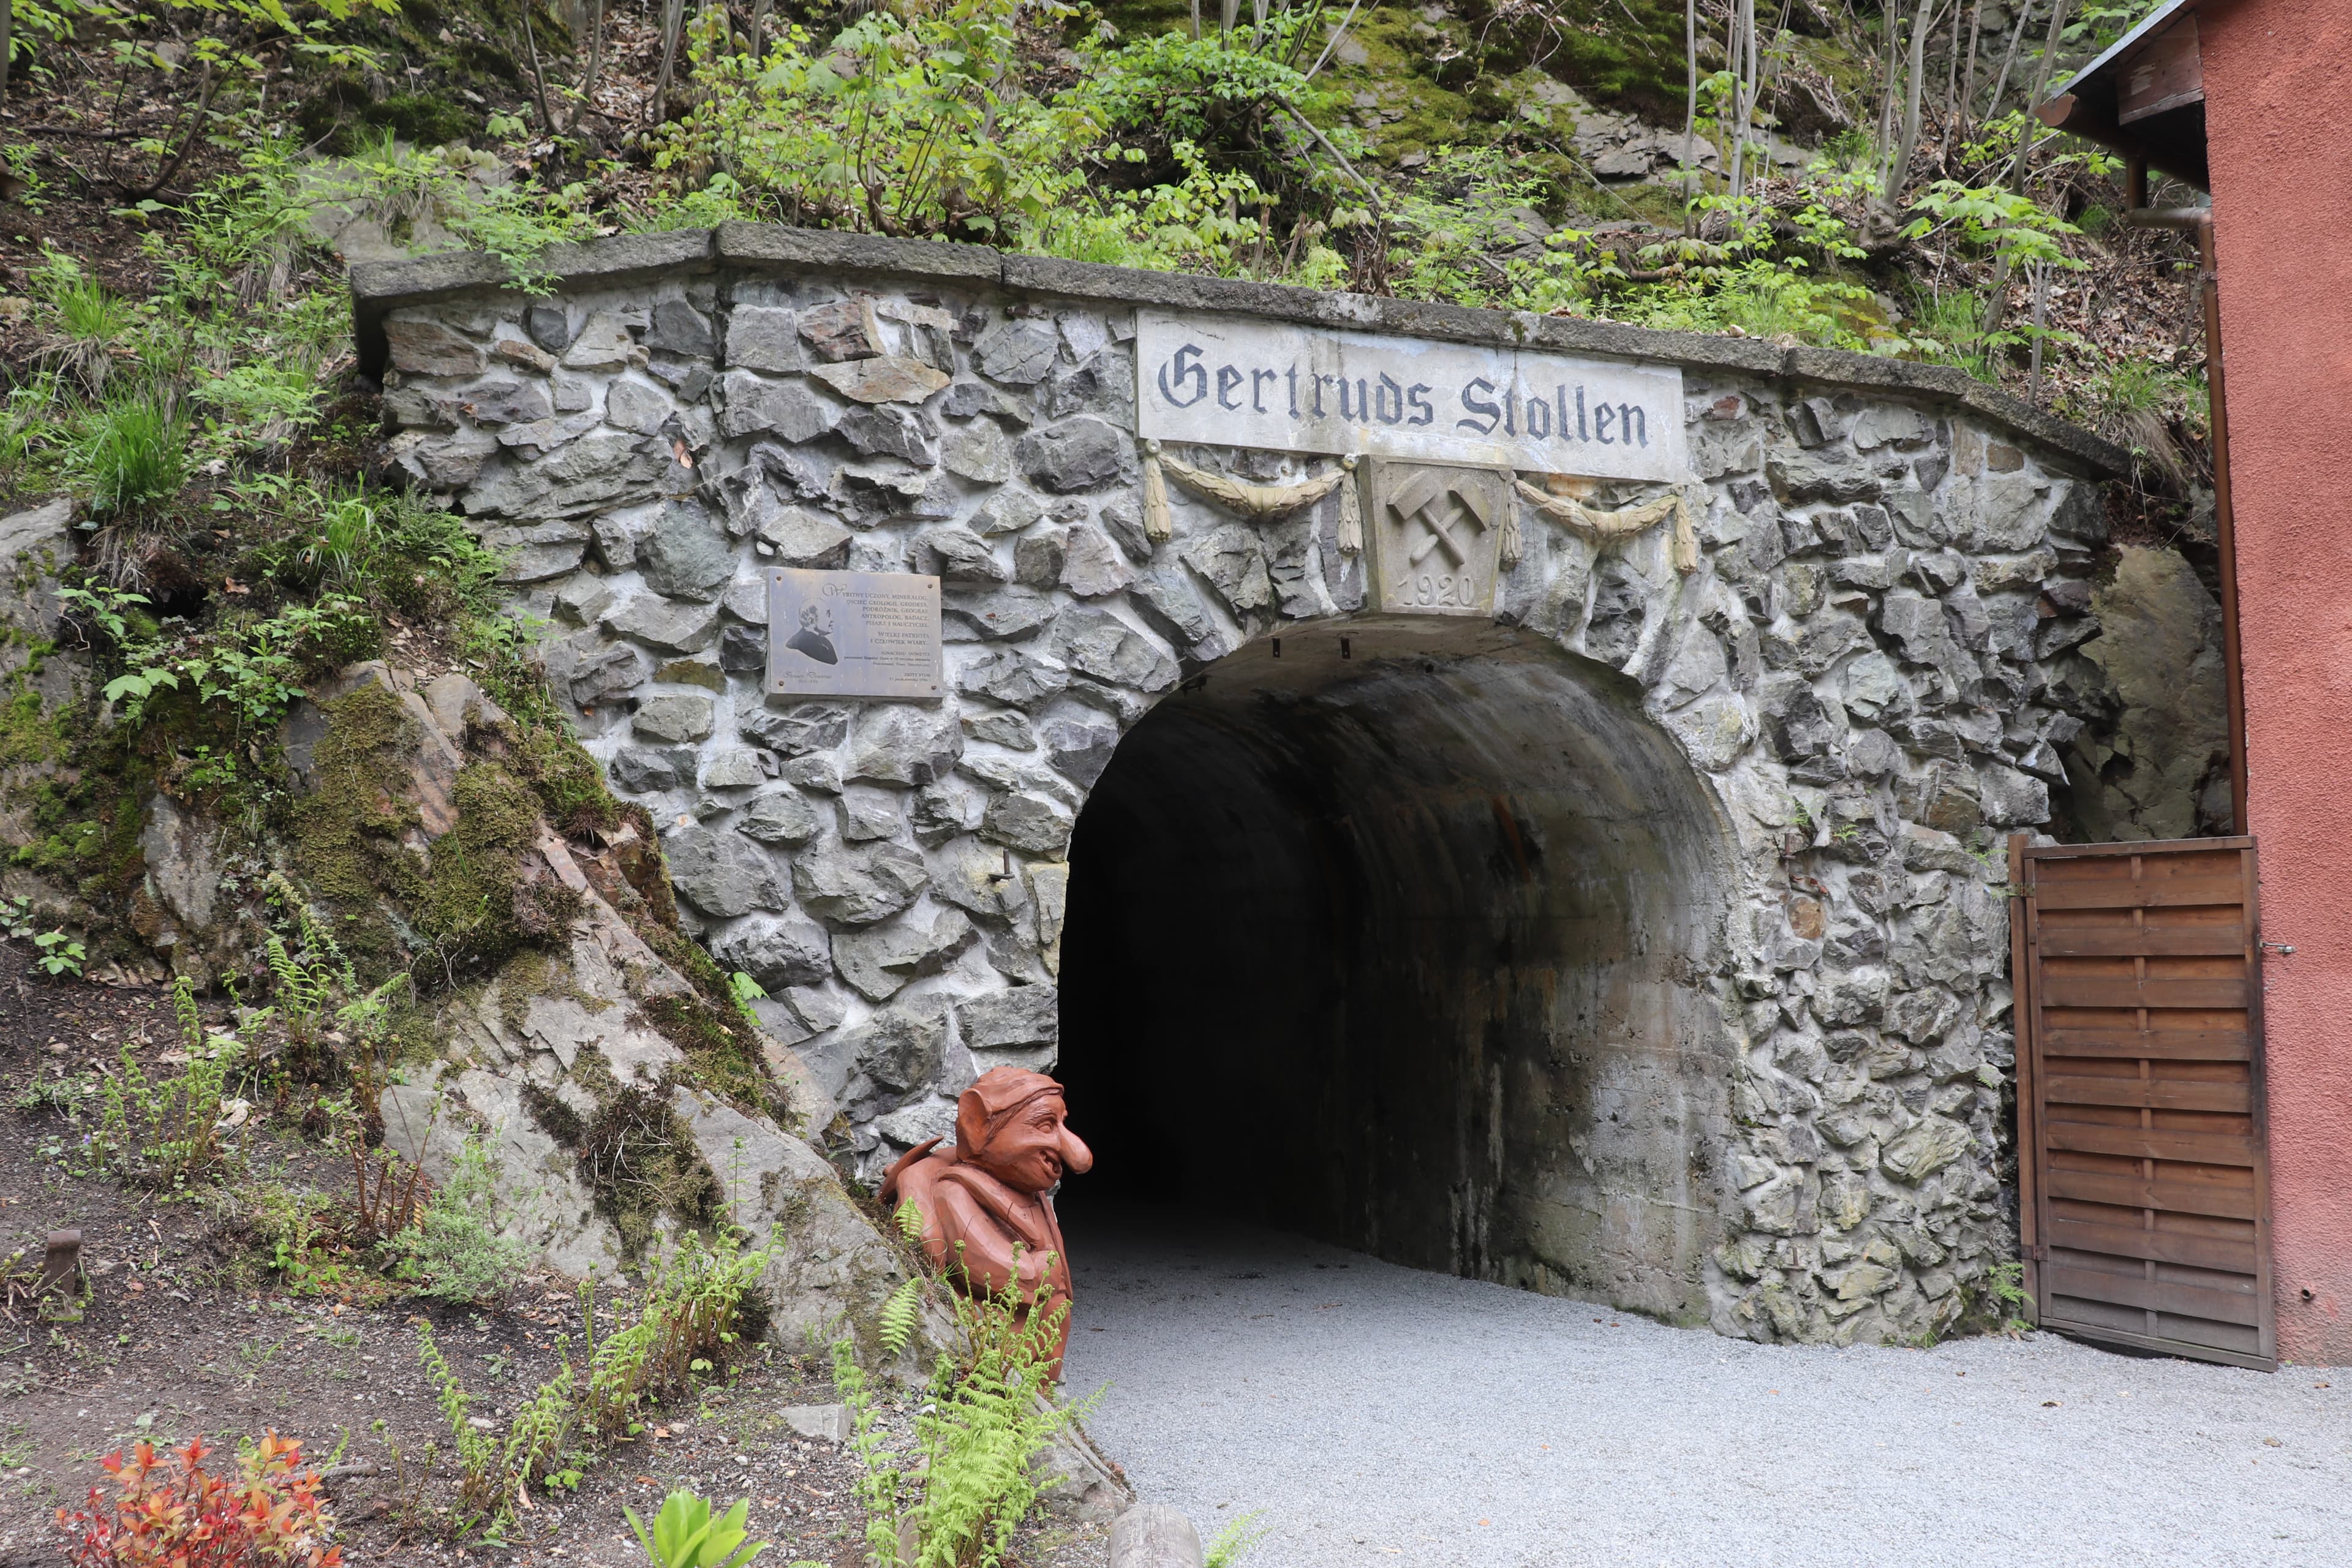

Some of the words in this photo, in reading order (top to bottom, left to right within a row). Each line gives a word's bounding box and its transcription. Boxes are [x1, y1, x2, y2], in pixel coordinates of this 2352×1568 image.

[1158, 343, 1434, 426] Gertruds
[1455, 376, 1648, 448] Stollen
[1398, 574, 1475, 606] 1920
